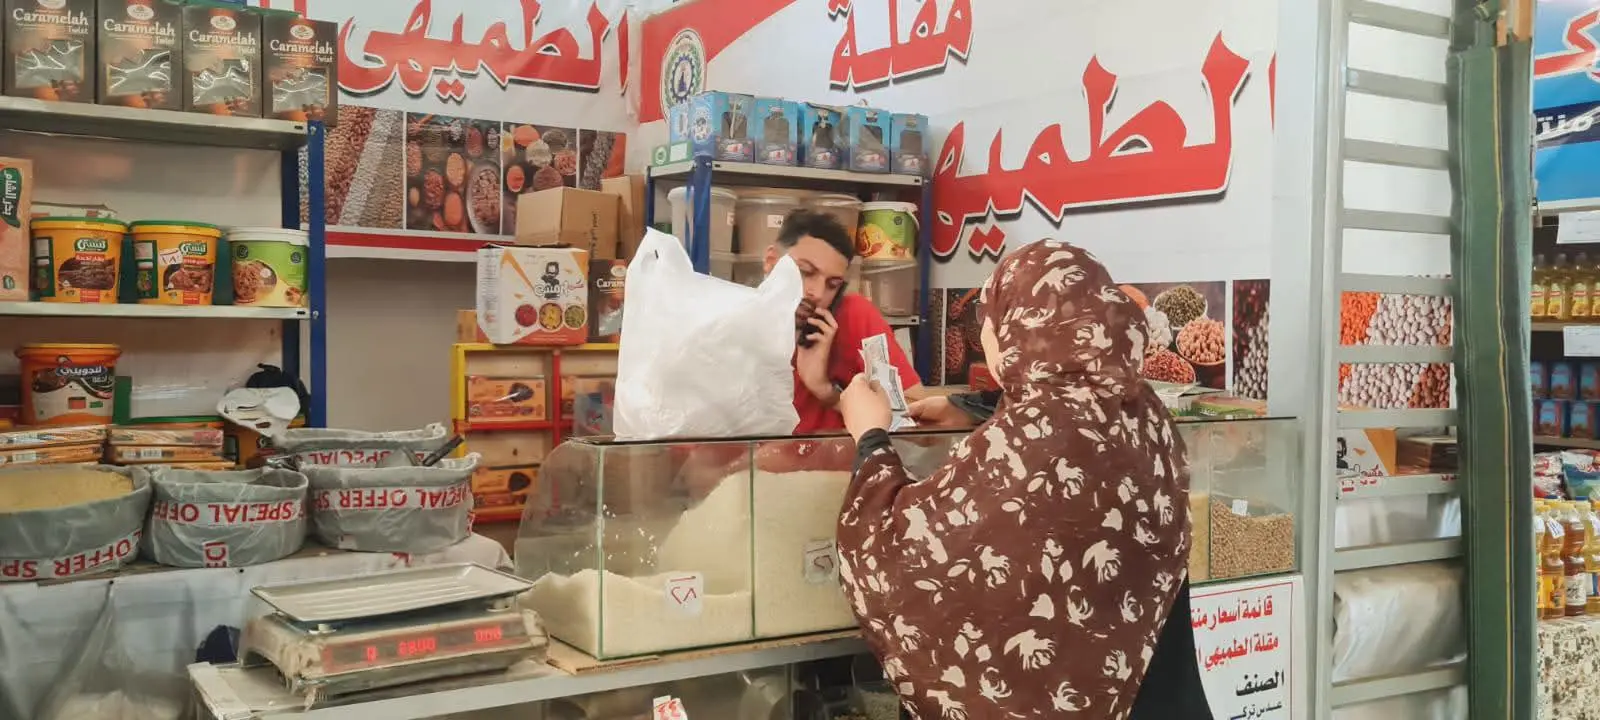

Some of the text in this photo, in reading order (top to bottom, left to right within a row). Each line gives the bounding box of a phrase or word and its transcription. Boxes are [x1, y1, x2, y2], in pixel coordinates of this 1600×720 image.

[12, 8, 89, 27] Caramelah
[104, 19, 175, 37] Caramelah
[188, 30, 256, 46] Caramelah
[270, 39, 333, 55] Caramelah
[339, 488, 407, 509] OFFER
[53, 539, 132, 576] OFFER
[1242, 595, 1273, 619] قائمة
[1254, 632, 1279, 652] مقلة
[1236, 670, 1285, 696] الصنف
